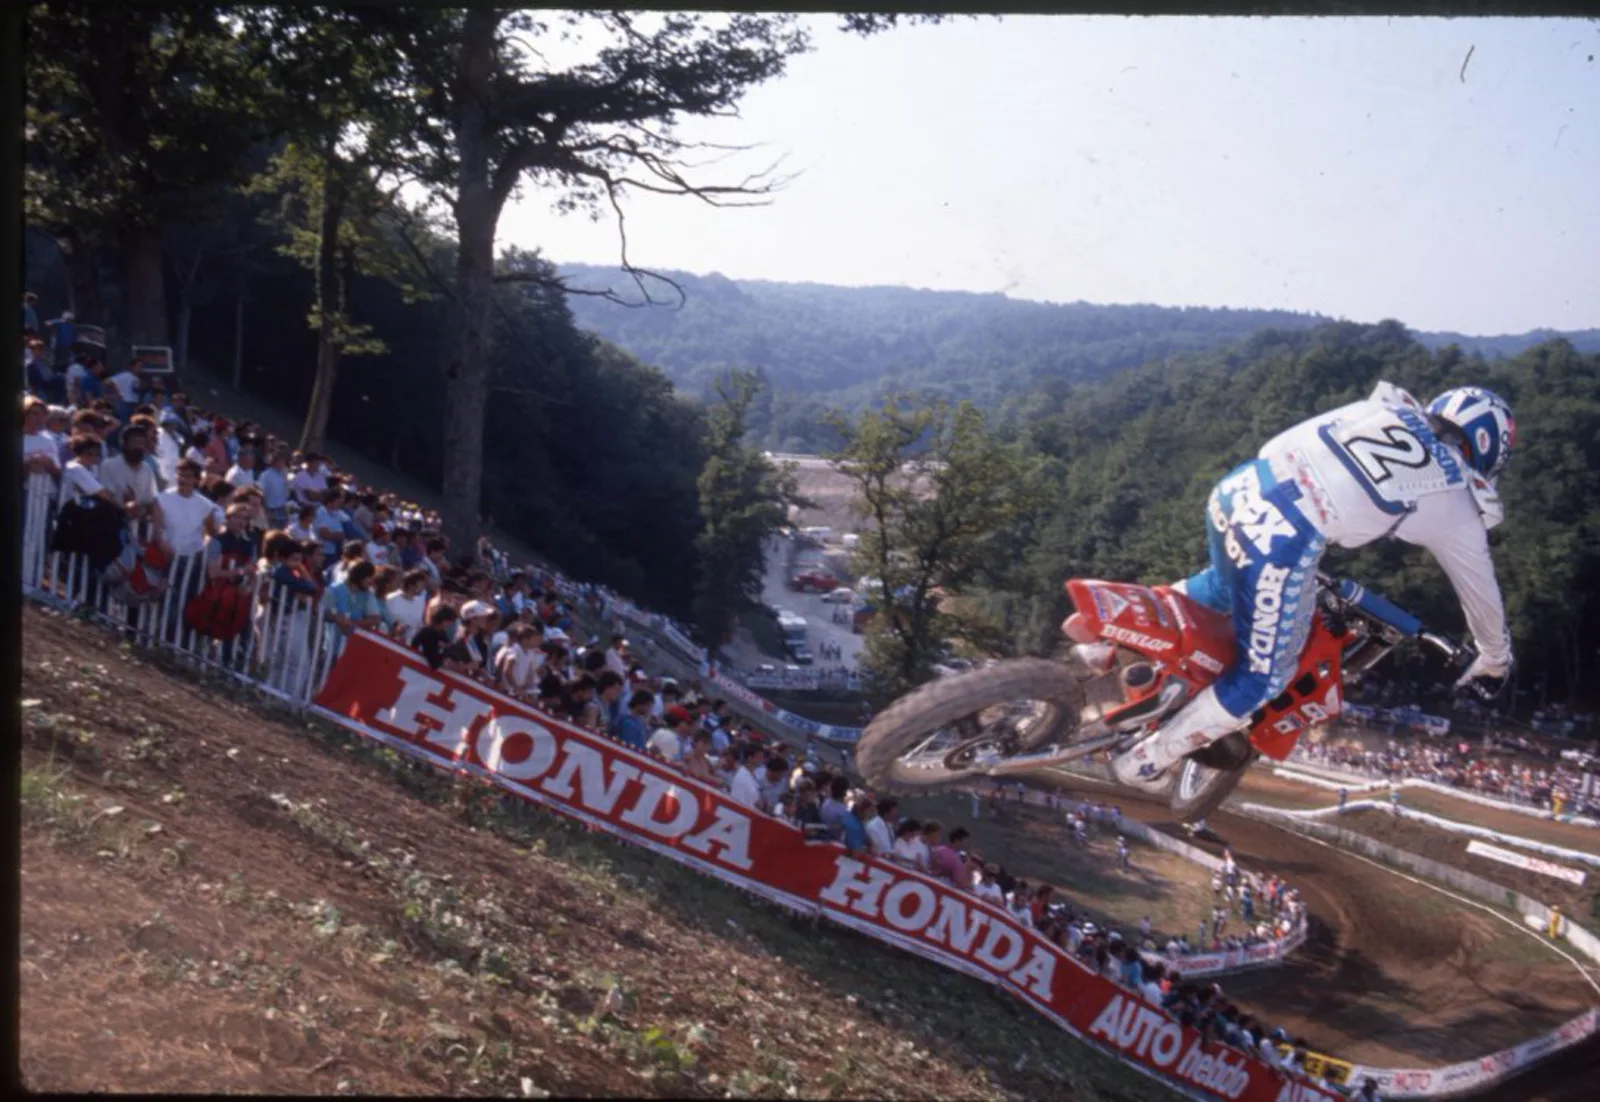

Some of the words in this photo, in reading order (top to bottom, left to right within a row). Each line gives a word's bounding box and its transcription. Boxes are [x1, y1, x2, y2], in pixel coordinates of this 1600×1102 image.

[1342, 424, 1431, 485] 2
[1099, 622, 1175, 652] DUNLOP
[1248, 561, 1292, 675] HONDA
[375, 666, 753, 871] HONDA
[819, 855, 1057, 1001] HONDA
[1088, 993, 1183, 1067] AUTO
